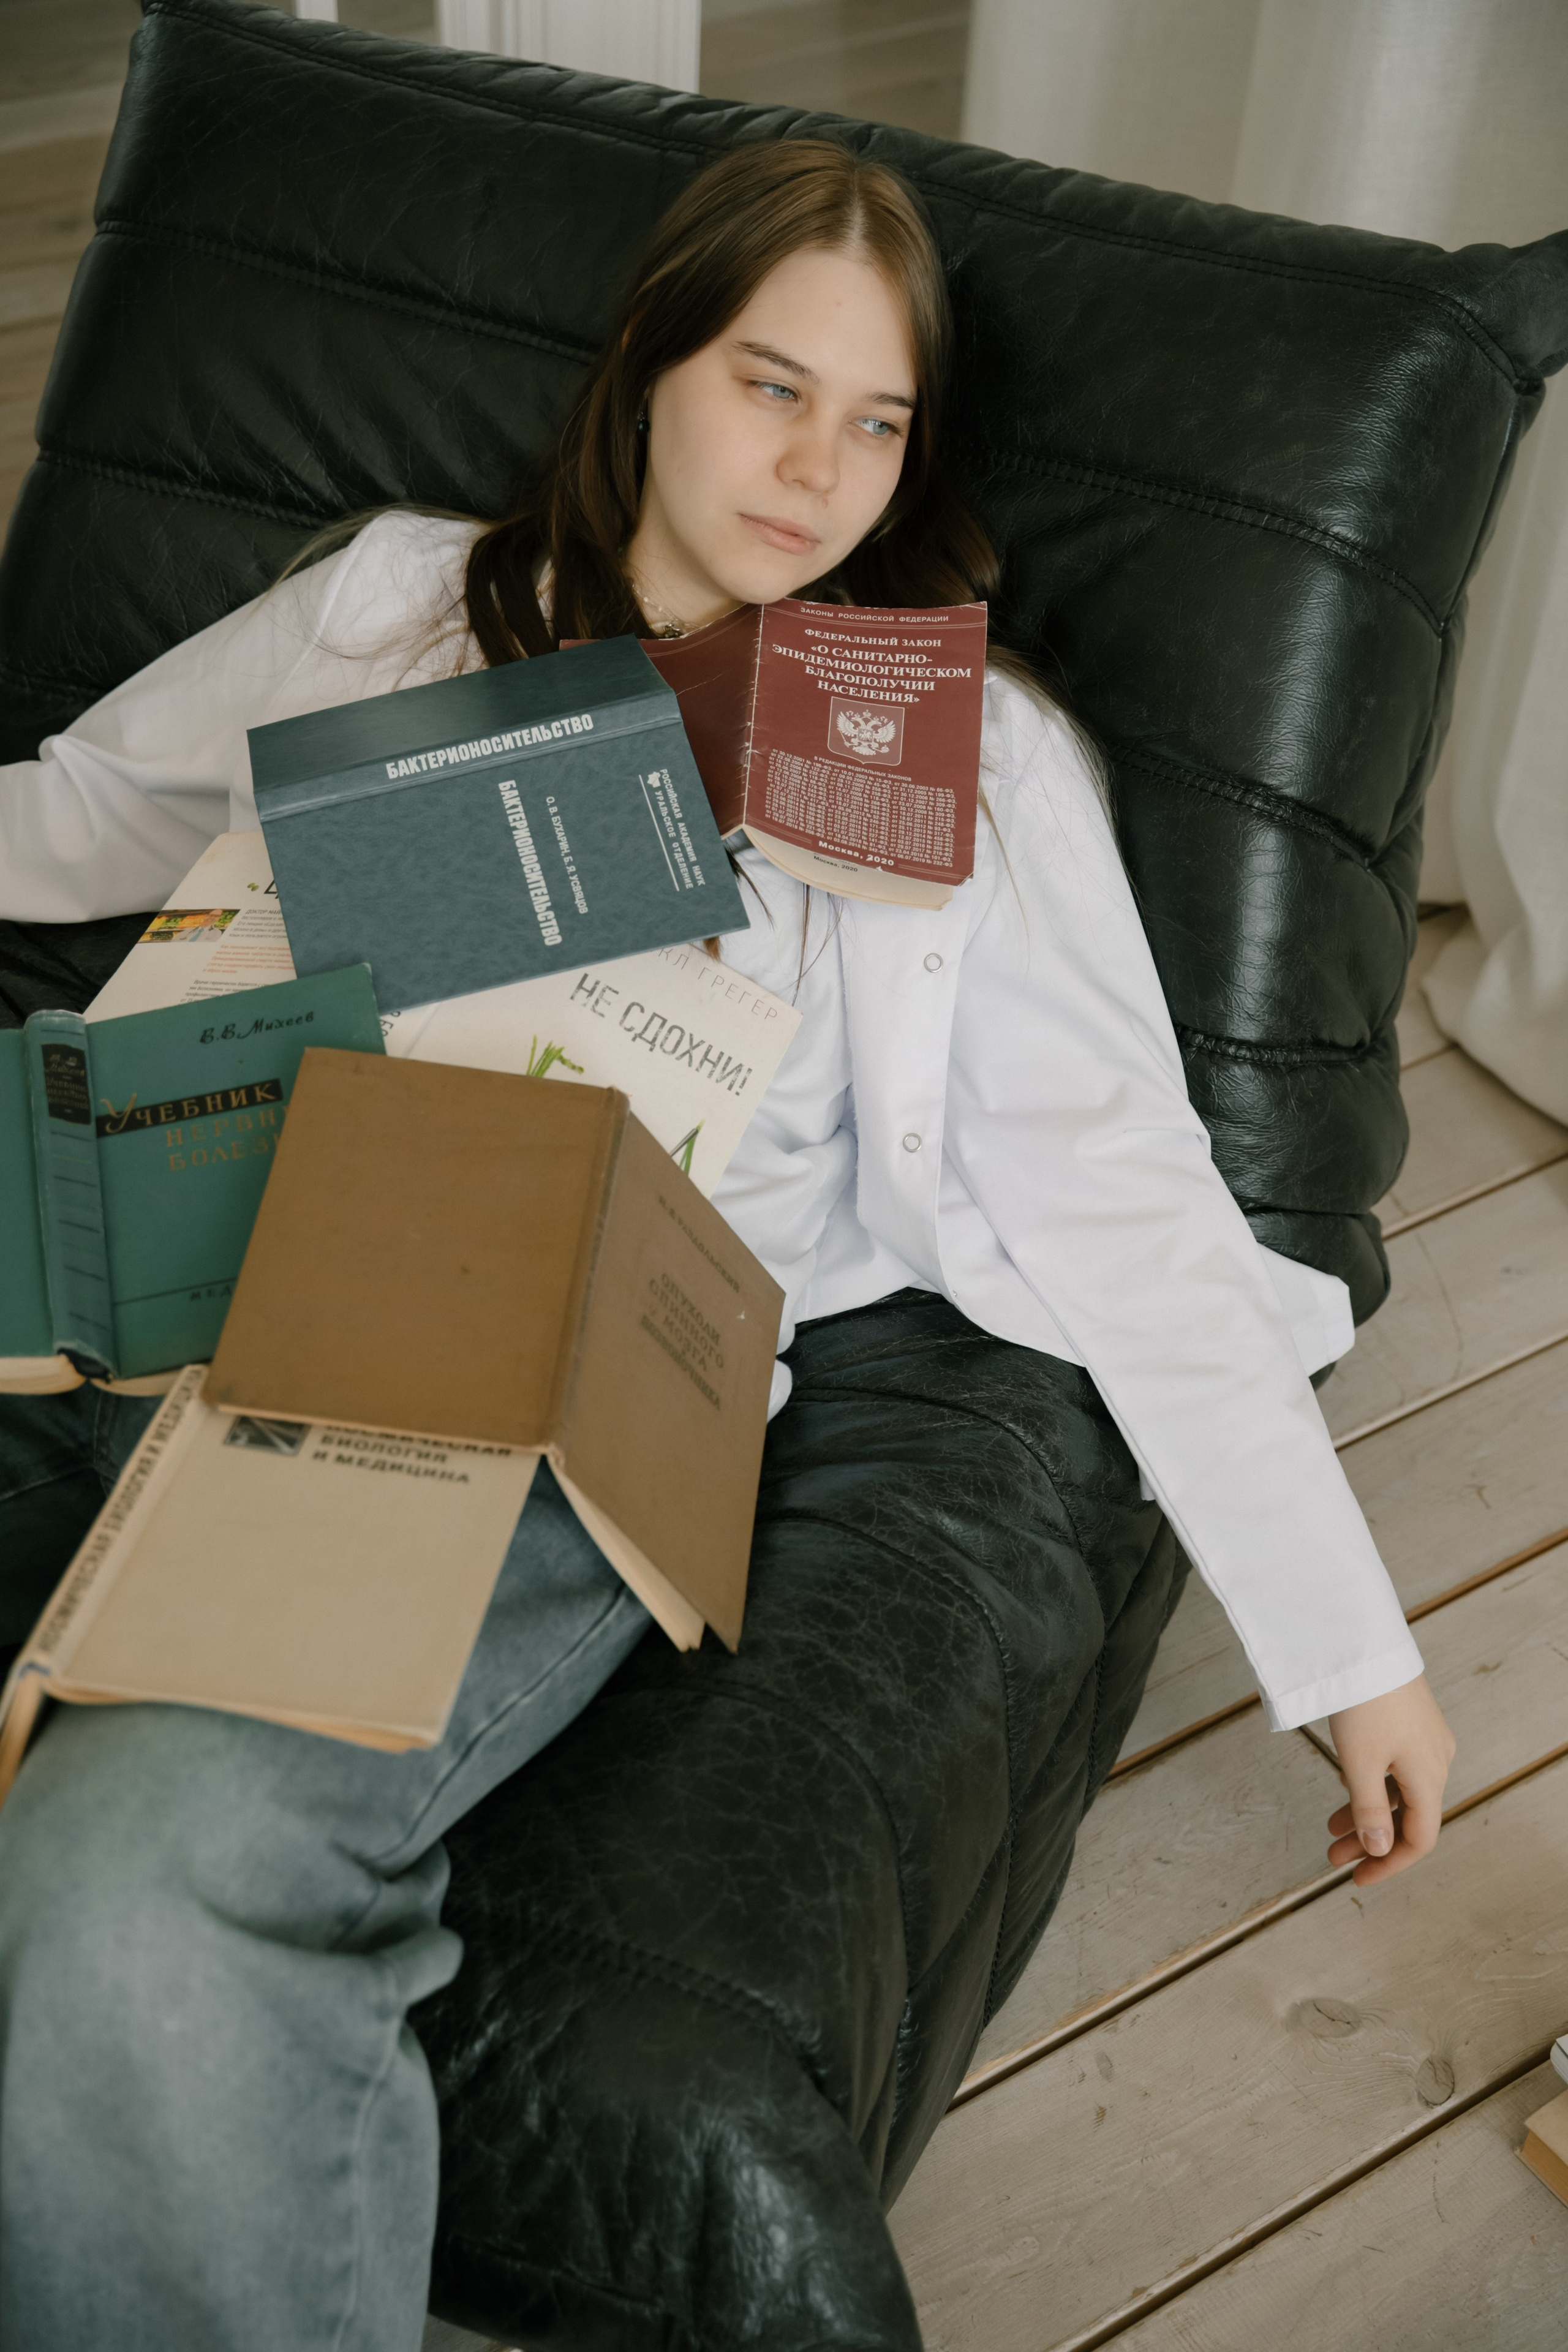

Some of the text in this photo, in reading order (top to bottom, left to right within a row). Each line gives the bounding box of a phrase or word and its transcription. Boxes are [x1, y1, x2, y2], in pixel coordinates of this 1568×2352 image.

[800, 607, 834, 617] ЗАКОНЫ
[838, 612, 894, 622] РОССИЙСКОЙ
[804, 628, 941, 647] ФЕДЕРАЛЬНЫЙ ЗАКОН
[810, 645, 933, 664] «О САНИТАРНО-
[772, 644, 971, 677] ЭПИДЕМИОЛОГИЧЕСКОМ
[805, 665, 935, 691] БЛАГОПОЛУЧИИ
[817, 680, 920, 703] НАСЕЛЕНИЯ»
[386, 714, 594, 779] БАКТЕРИОНОСИТЕЛЬСТВО
[818, 758, 846, 767] РЕДАКЦИИ
[847, 765, 886, 777] ФЕДЕРАЛЬНЫХ
[655, 790, 693, 889] УРАЛЬСКОЕ ОТДЕЛЕНИЕ
[660, 769, 706, 886] РОССИЙСКАЯ АКАДЕМИЯ НАУК
[499, 780, 562, 946] БАКТЕРИОНОСИТЕЛЬСТВО
[546, 796, 588, 914] О. В. БУХАРИН, Б. Я. УСВЯЦОВ
[819, 840, 894, 865] Москва, 2020
[650, 947, 778, 1020] КЛ ГРЕГЕР
[570, 973, 753, 1096] НЕ СДОХНИ!
[166, 1105, 288, 1147] НЕРВН
[169, 1134, 280, 1172] БОЛЕЗ
[319, 1433, 449, 1464] БИОЛОГИЯ
